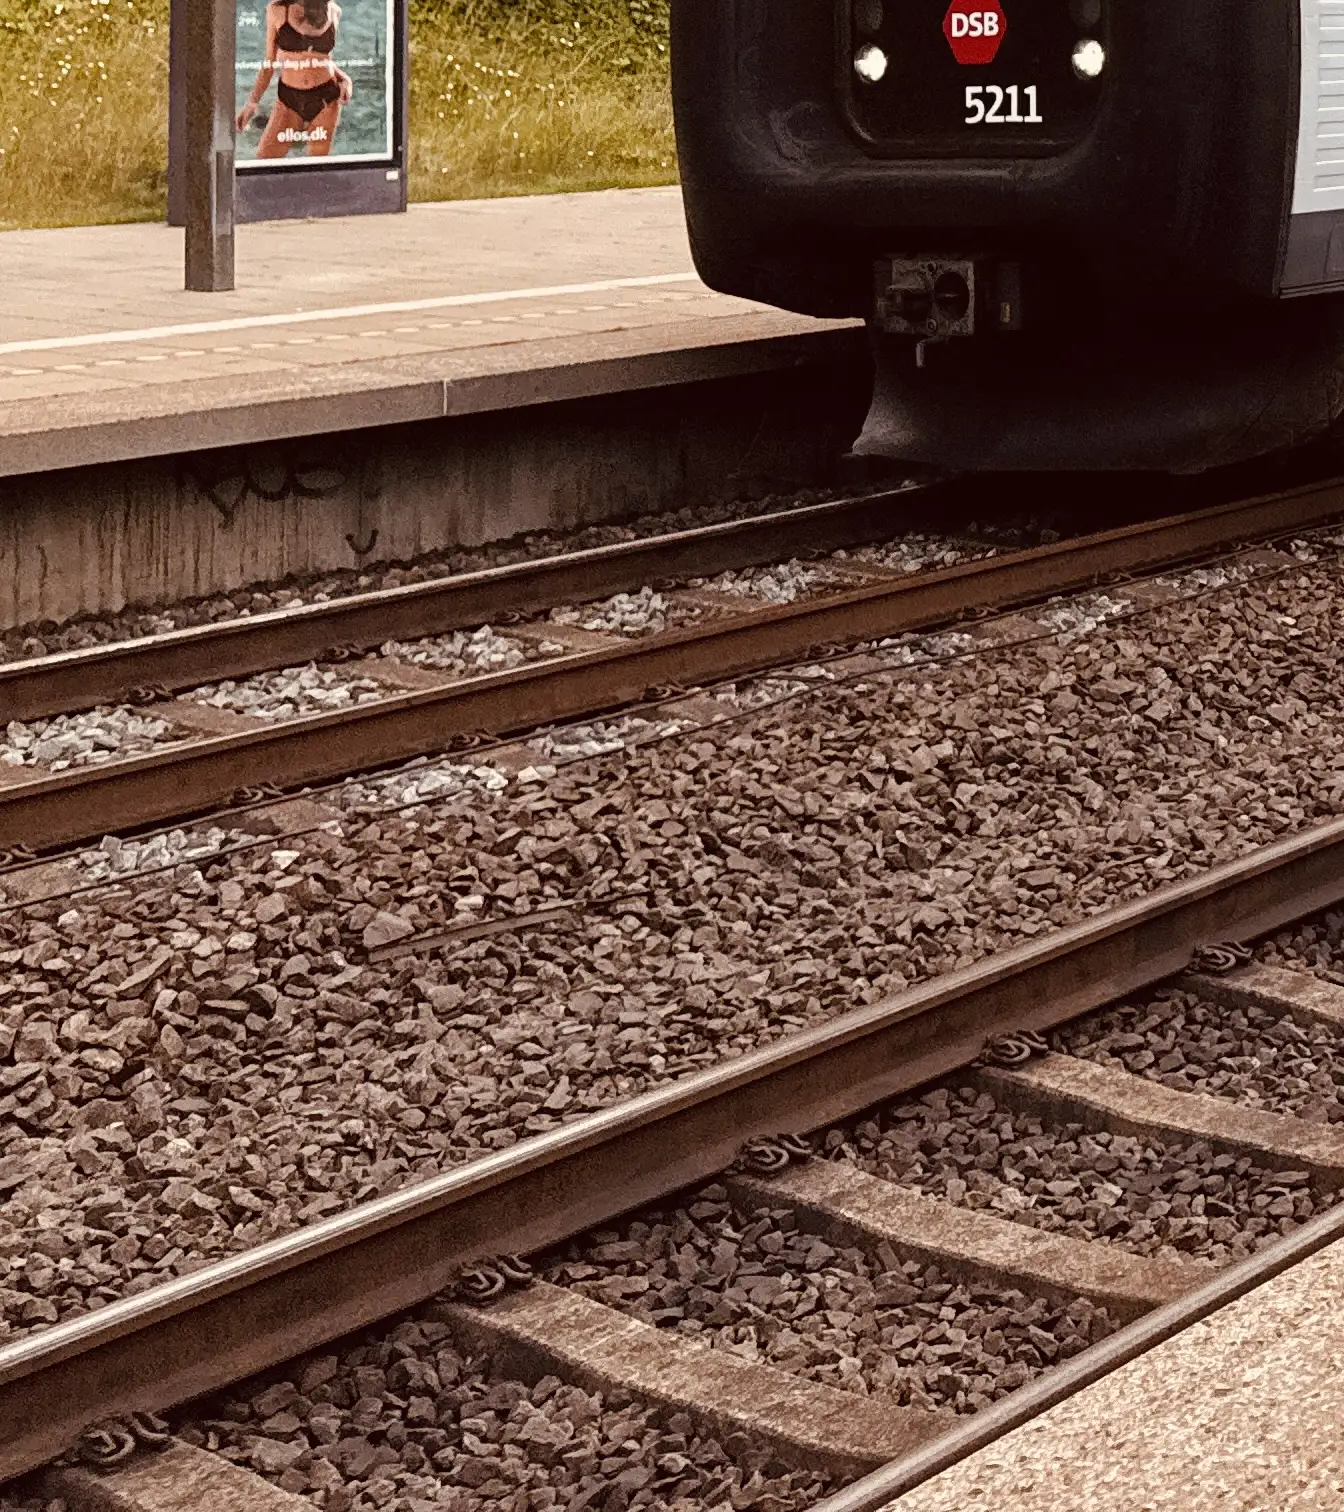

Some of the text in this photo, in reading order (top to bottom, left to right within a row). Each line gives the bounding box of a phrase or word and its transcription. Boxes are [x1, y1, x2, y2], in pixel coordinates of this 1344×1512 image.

[951, 11, 999, 38] DSB
[965, 85, 1043, 124] 5211
[277, 126, 328, 143] ellos.dk
